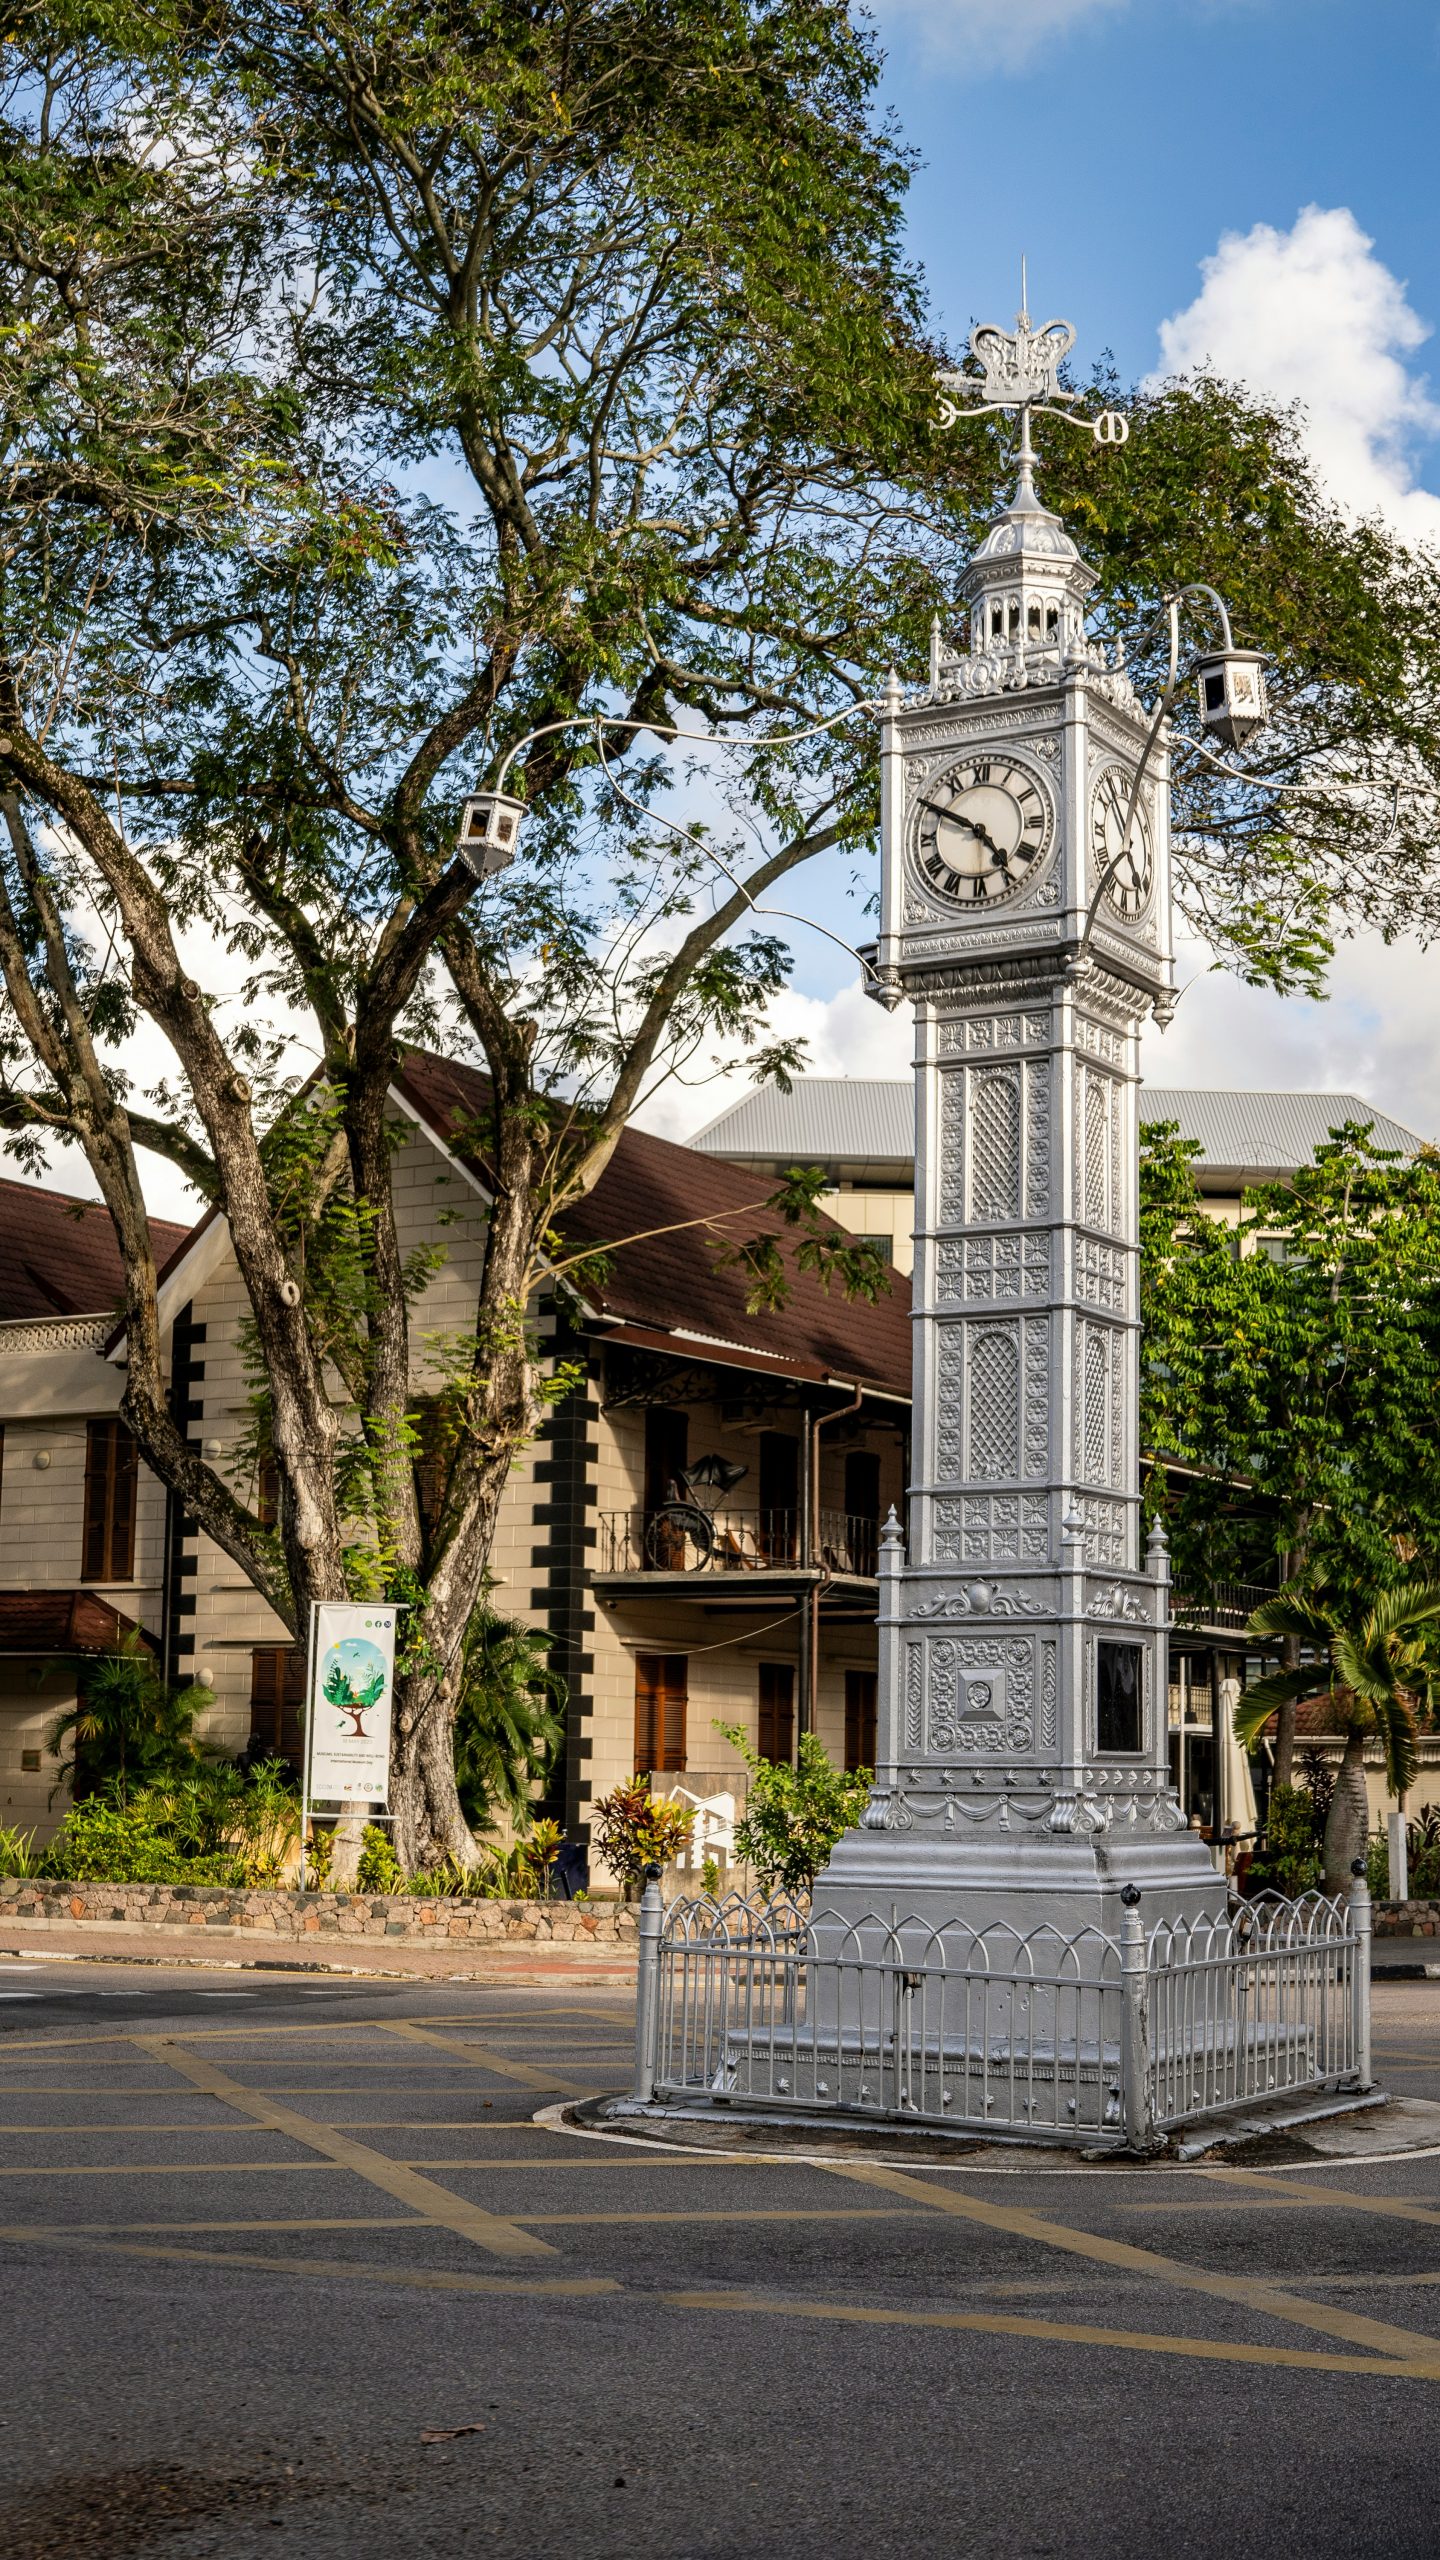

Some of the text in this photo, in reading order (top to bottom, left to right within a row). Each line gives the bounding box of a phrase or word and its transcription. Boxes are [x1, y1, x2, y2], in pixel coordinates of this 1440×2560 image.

[973, 764, 991, 784] XII
[946, 776, 964, 797] XI
[1016, 787, 1035, 803] II
[1024, 815, 1043, 829] III
